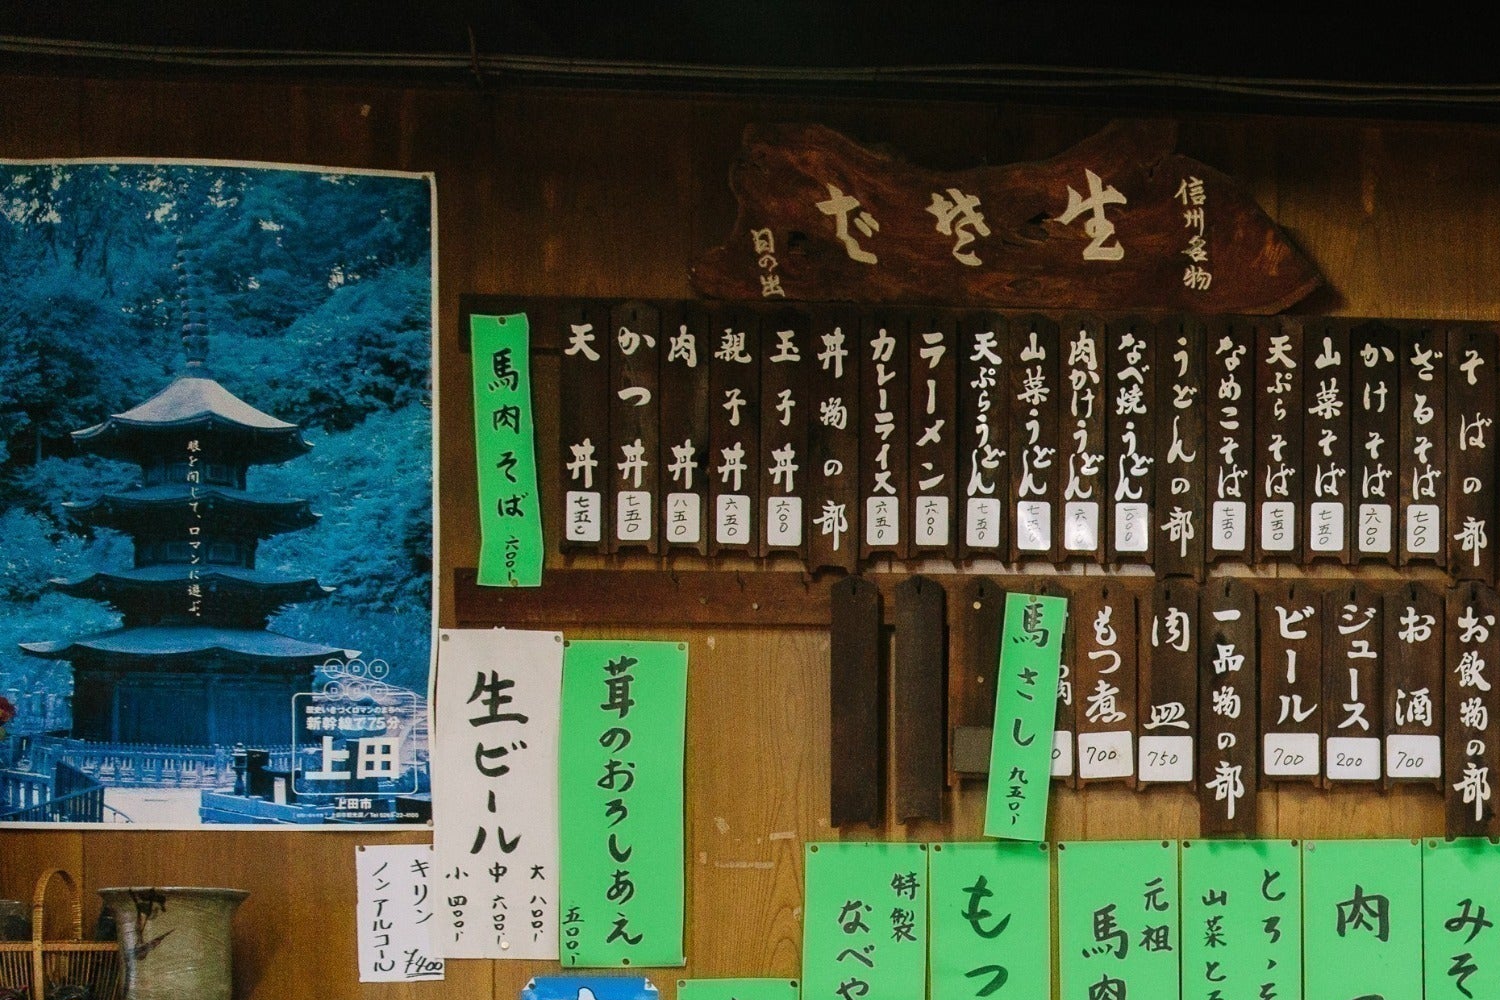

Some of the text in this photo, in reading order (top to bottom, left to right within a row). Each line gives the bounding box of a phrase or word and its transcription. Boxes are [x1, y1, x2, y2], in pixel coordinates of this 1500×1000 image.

[751, 229, 785, 298] 日の出
[1175, 177, 1211, 290] 信州名物
[488, 348, 528, 518] 馬肉そば
[564, 324, 600, 489] 天丼
[618, 326, 656, 489] かつ丼
[667, 326, 698, 489] 肉丼
[714, 328, 751, 491] 親子丼
[769, 330, 800, 491] 玉子丼
[813, 328, 848, 551] 丼物の部
[871, 329, 896, 494] カレーライス
[916, 332, 946, 490] ラーメン
[967, 331, 1006, 496] 天ぷらうどん
[1017, 332, 1055, 498] 山菜うどん
[1065, 331, 1104, 499] 肉かけうどん
[1115, 333, 1154, 500] なべ焼うどん
[1160, 338, 1196, 558] うどんの部
[1216, 337, 1248, 498] なめこそば
[1265, 335, 1296, 498] 天ぷらそば
[1309, 338, 1345, 498] 山菜そば
[1360, 343, 1395, 498] かけそば
[1410, 342, 1442, 498] ざるそば
[1453, 350, 1492, 566] そばの部
[1012, 603, 1049, 747] 馬さし
[1085, 606, 1126, 724] もつ煮
[1143, 607, 1190, 729] 肉皿
[1205, 609, 1245, 820] 一品物の部
[1275, 605, 1318, 725] ビール
[1338, 604, 1378, 731] ジュース
[1395, 606, 1435, 727] お酒
[1452, 606, 1495, 822] お飲物の部
[305, 736, 400, 780] 上田
[335, 798, 372, 810] 上田市
[466, 670, 529, 854] 生ビール
[597, 656, 643, 945] 茸のおろしあえ
[1087, 747, 1117, 764] 700
[1147, 752, 1178, 767] 750
[1274, 748, 1304, 765] 700
[1336, 754, 1363, 767] 200
[1396, 752, 1424, 769] 700
[372, 861, 395, 972] ノンアルコール
[410, 858, 433, 924] キリン
[445, 867, 469, 880] 小
[489, 862, 508, 883] 中
[531, 864, 545, 880] 大
[890, 871, 920, 943] 特製
[1138, 877, 1173, 952] 元祖
